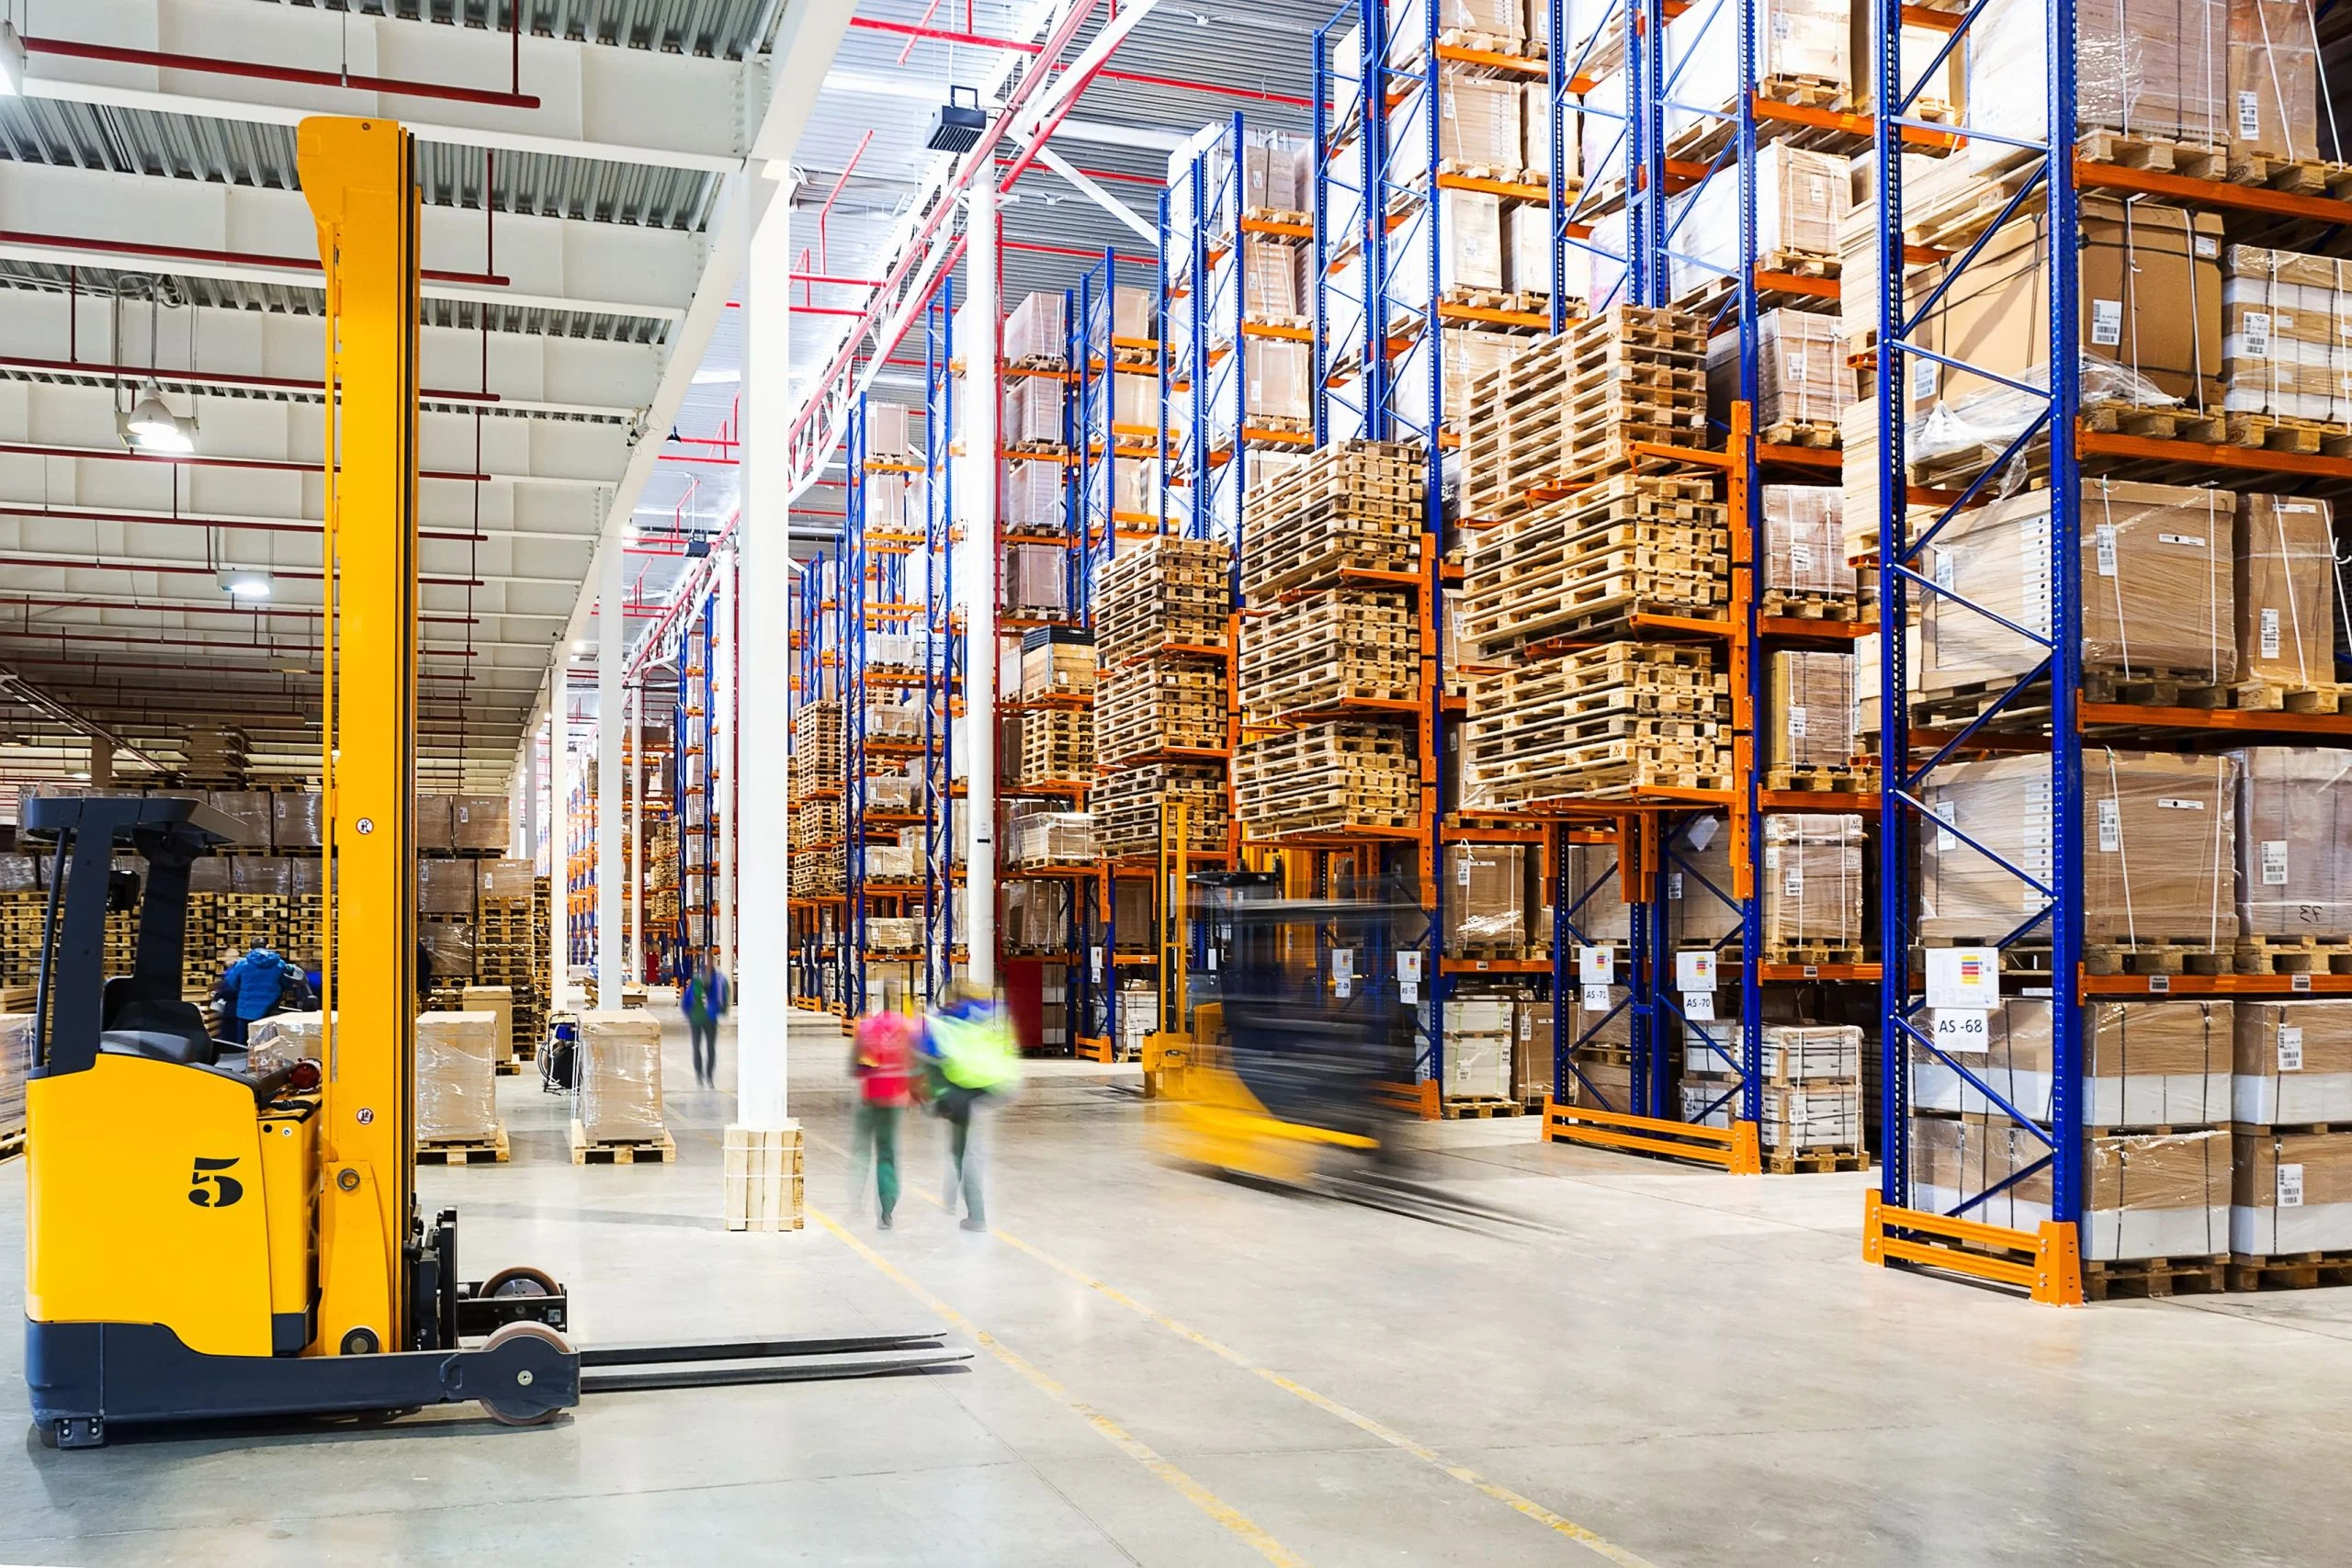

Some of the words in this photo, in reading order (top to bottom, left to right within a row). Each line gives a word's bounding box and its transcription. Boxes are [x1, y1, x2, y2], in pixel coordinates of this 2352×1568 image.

[1686, 998, 1697, 1007] AS
[1939, 1019, 1956, 1032] AS
[188, 1156, 243, 1208] 5
